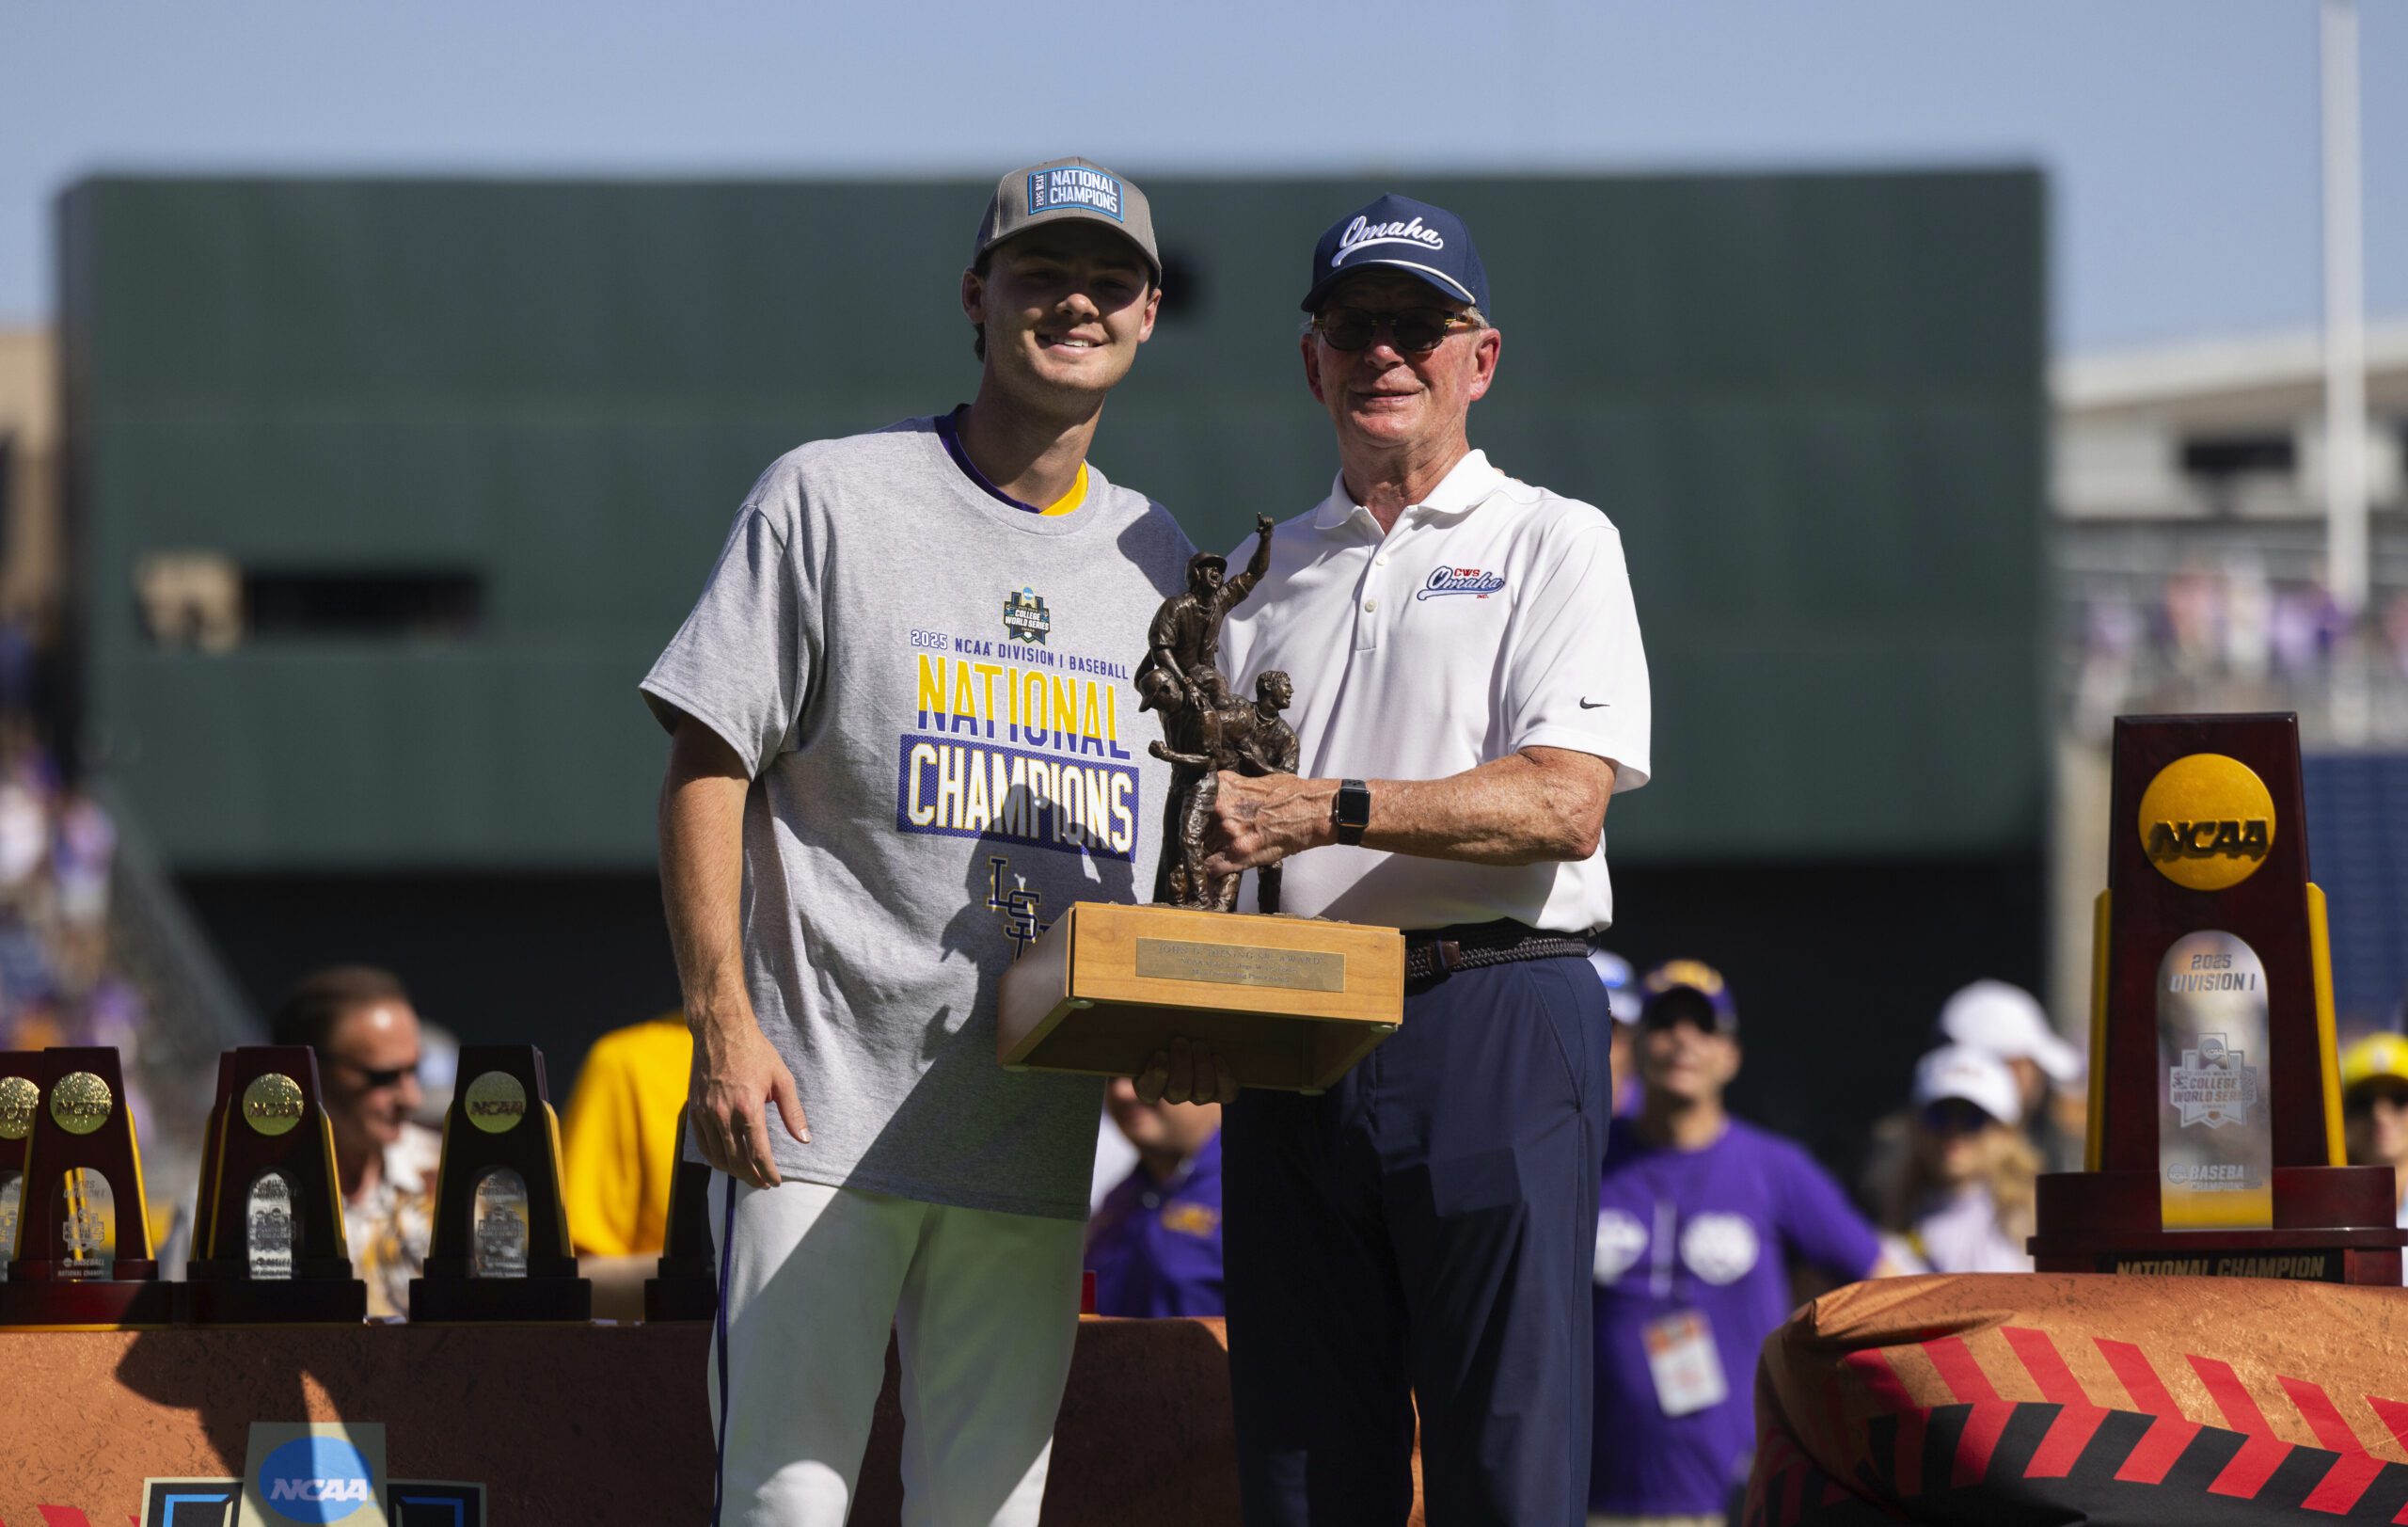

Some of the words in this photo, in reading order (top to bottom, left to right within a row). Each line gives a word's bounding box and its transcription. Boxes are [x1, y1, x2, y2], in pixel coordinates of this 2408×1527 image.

[1051, 169, 1117, 197] NATIONAL
[1036, 191, 1044, 207] 2025
[1050, 186, 1117, 214] CHAMPIONS
[1336, 215, 1443, 252] Omaha
[1421, 565, 1504, 595] Omaha
[1453, 568, 1481, 578] CWS
[1005, 616, 1027, 628] WORLD
[1028, 620, 1050, 630] SERIES
[1015, 610, 1040, 621] COLLEGE
[911, 630, 948, 649] 2025
[998, 644, 1054, 667] DIVISION
[1059, 654, 1063, 668] I
[1069, 657, 1129, 680] BASEBALL
[917, 652, 1132, 761] NATIONAL
[907, 742, 1133, 854] CHAMPIONS
[2148, 819, 2271, 861] NCAA
[1279, 955, 1321, 965] AWARD
[2191, 954, 2232, 970] 2025
[2169, 973, 2245, 993] DIVISION
[2250, 974, 2256, 991] I
[2190, 1077, 2238, 1090] COLLEGE
[2174, 1090, 2213, 1103] WORLD
[472, 1101, 523, 1115] NCAA
[2116, 1259, 2210, 1276] NATIONAL
[2216, 1256, 2325, 1279] CHAMPION
[269, 1478, 368, 1502] NCAA
